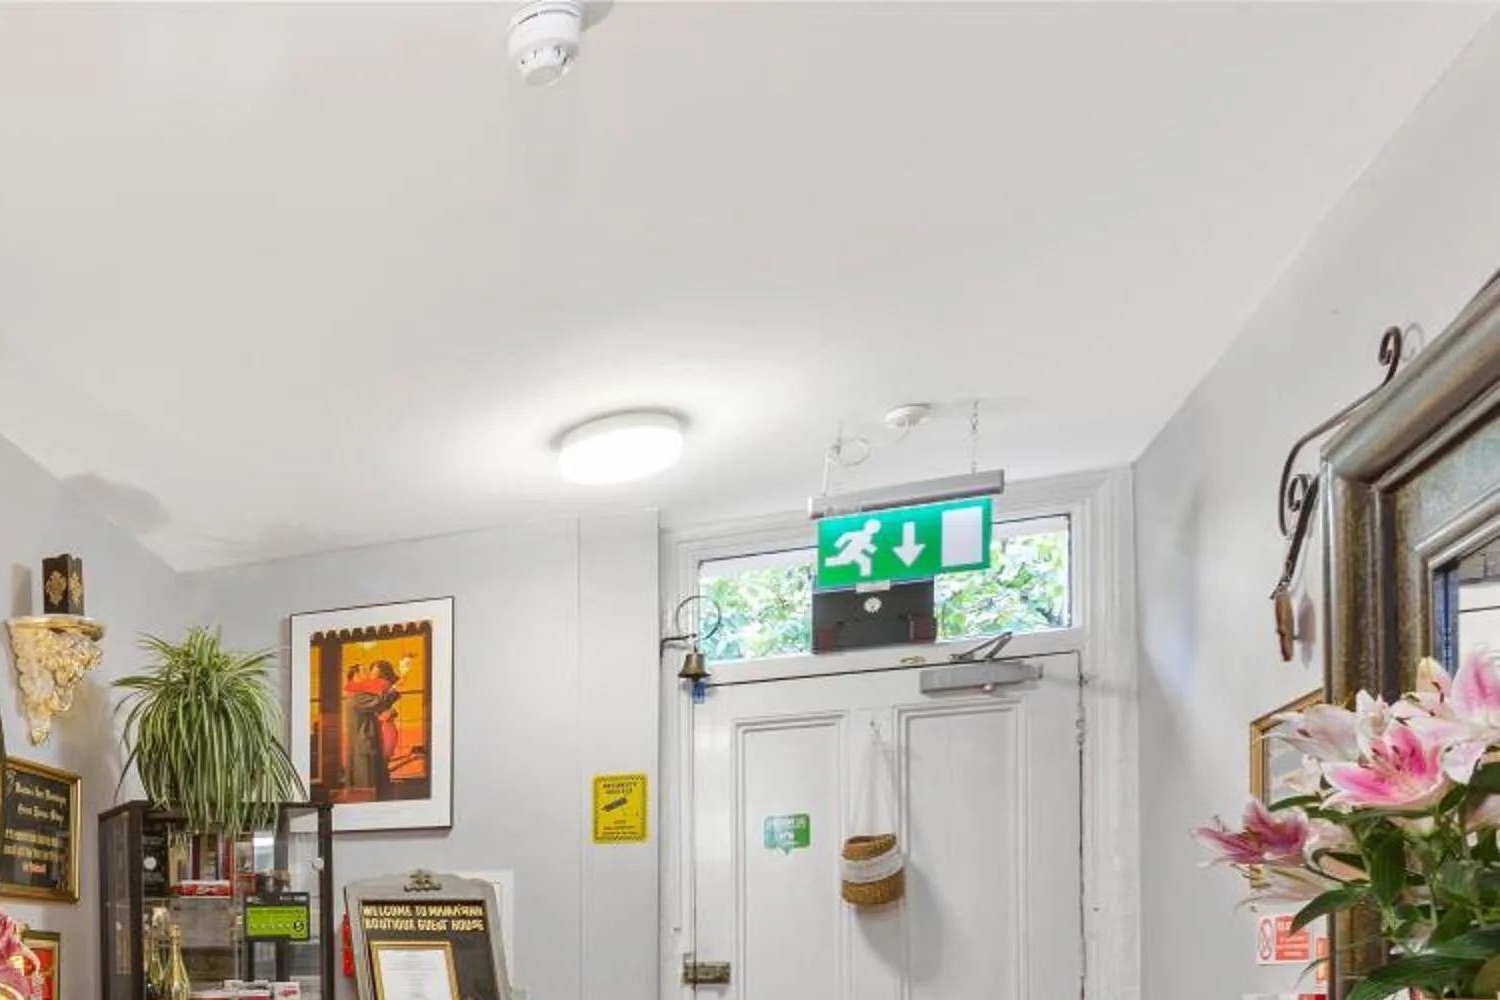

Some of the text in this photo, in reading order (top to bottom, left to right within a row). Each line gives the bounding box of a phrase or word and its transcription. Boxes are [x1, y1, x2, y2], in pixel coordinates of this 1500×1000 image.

[363, 904, 413, 917] WELCOME
[365, 917, 485, 931] BOUTIQUE GUEST HOUSE
